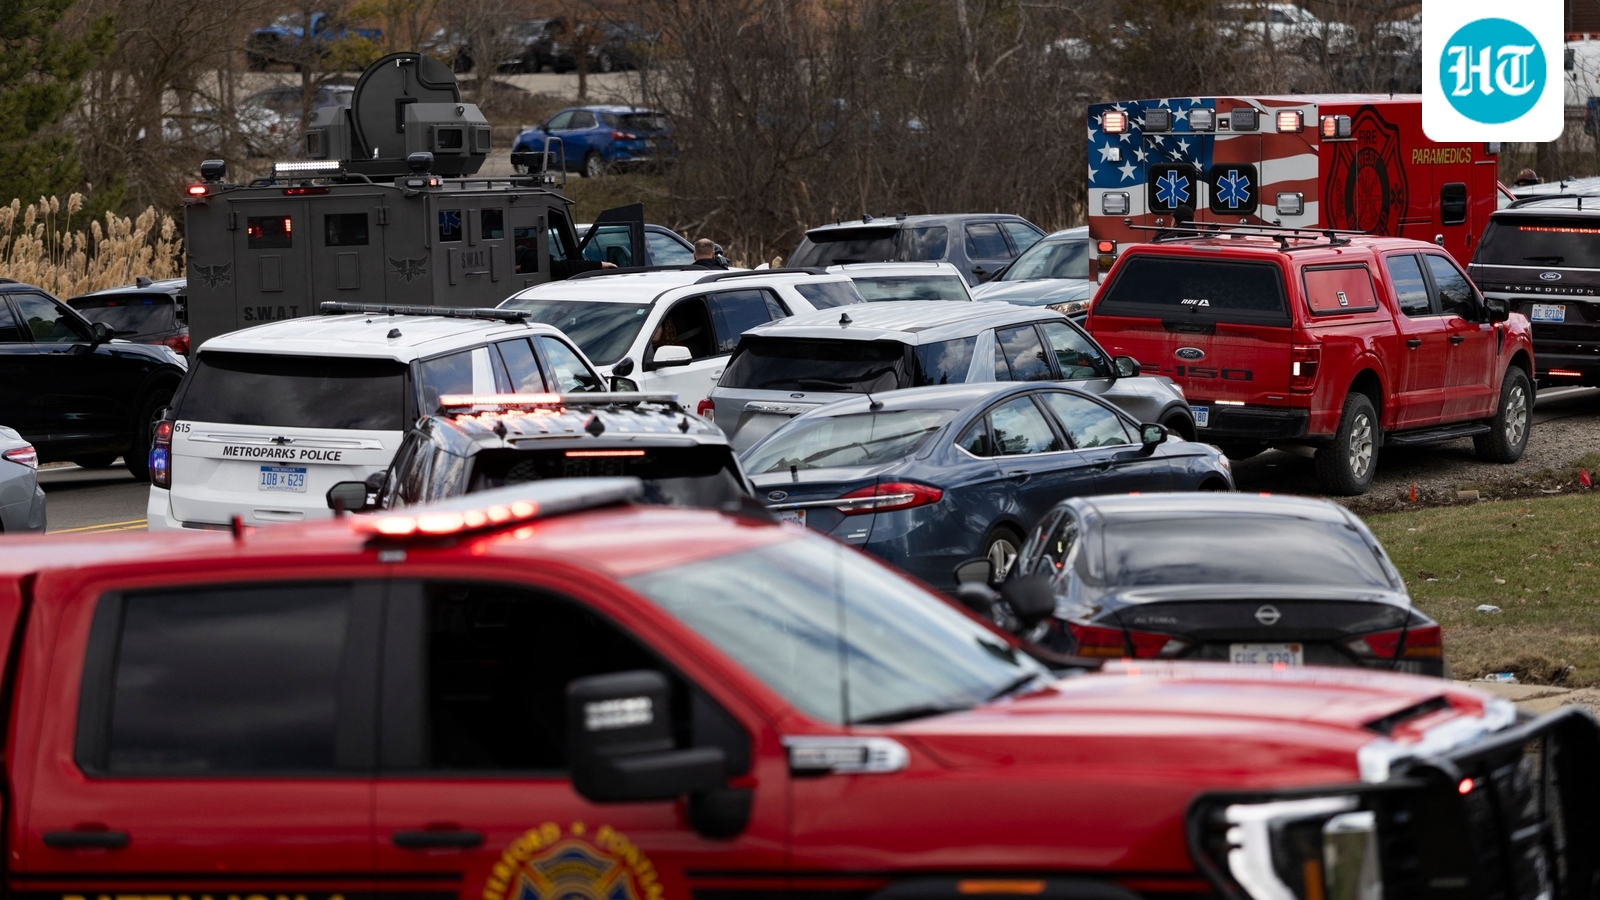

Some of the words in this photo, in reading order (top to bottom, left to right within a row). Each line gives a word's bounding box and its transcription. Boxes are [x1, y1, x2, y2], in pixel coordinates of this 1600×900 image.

[1358, 129, 1377, 145] FIRE
[1358, 150, 1380, 169] WEST
[1411, 147, 1472, 165] PARAMEDICS
[1505, 286, 1594, 295] EXPEDITION
[174, 422, 191, 434] 615
[222, 446, 296, 460] METROPARKS
[299, 449, 342, 462] POLICE
[261, 472, 278, 486] 108
[287, 473, 304, 487] 629
